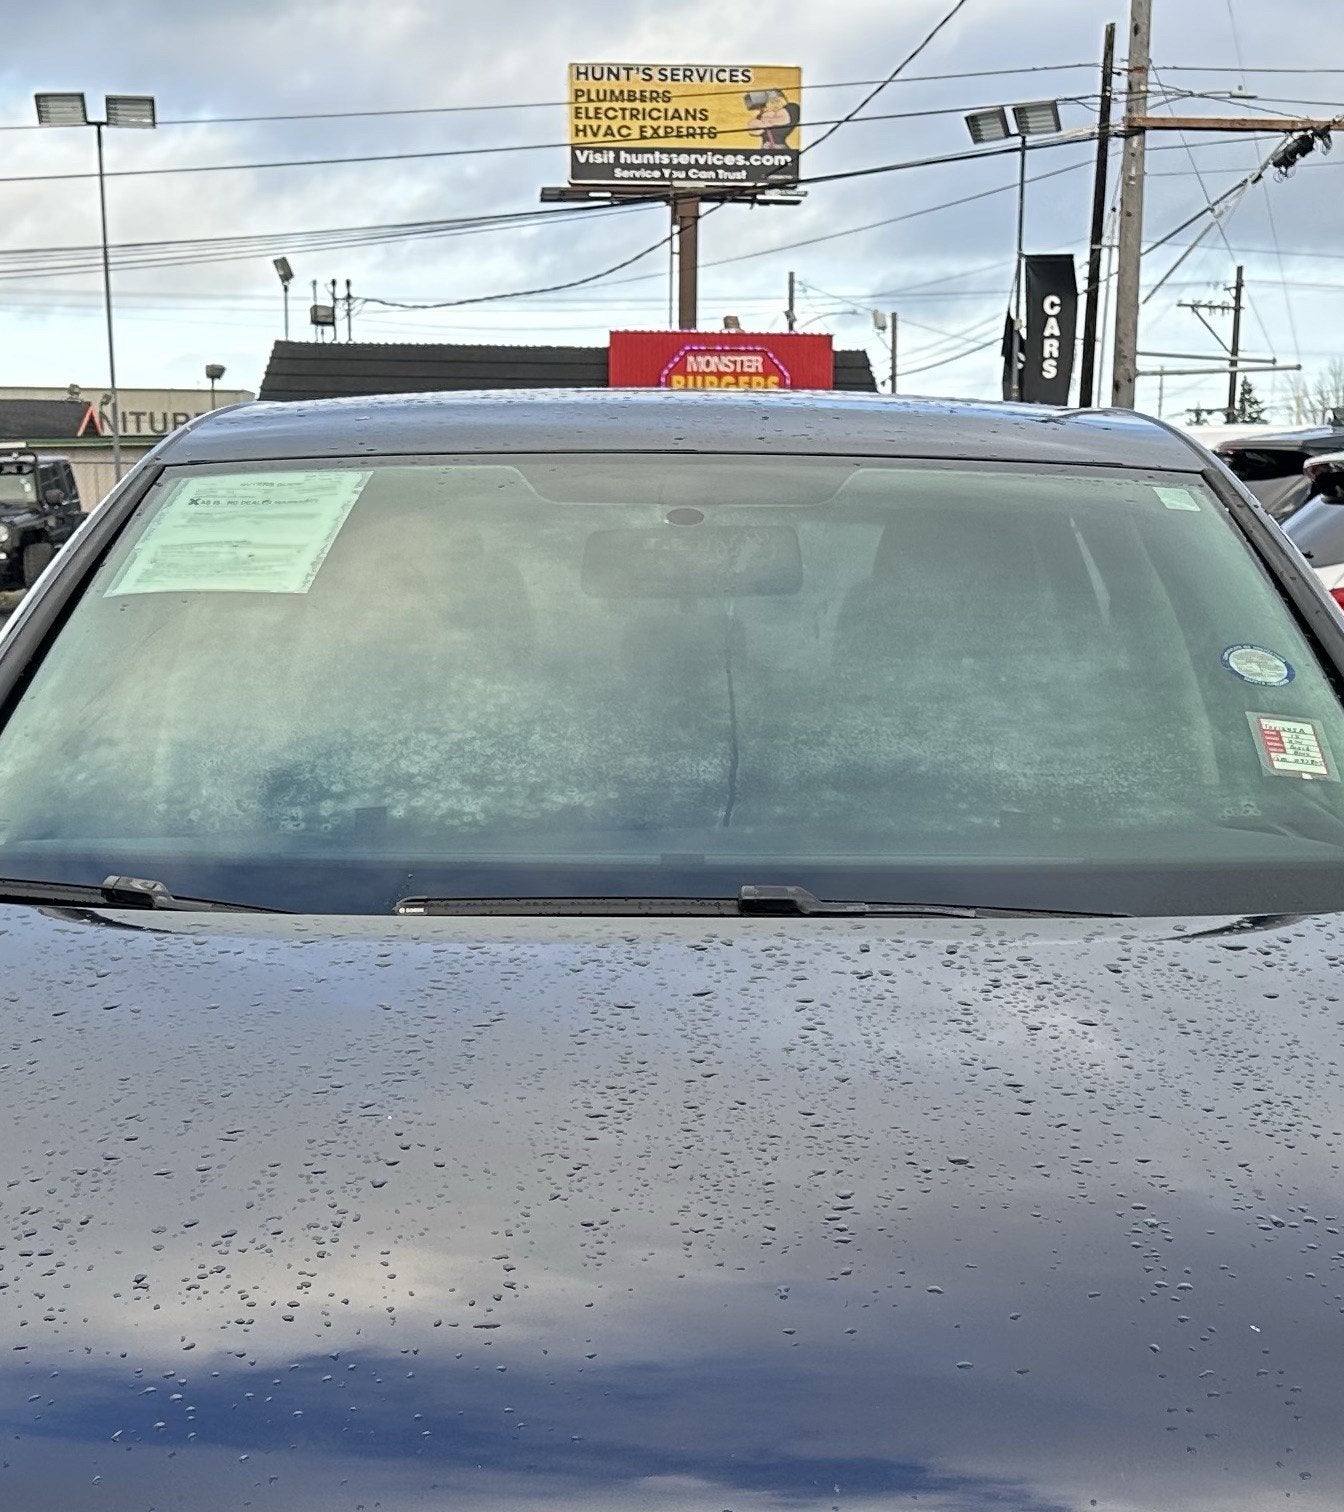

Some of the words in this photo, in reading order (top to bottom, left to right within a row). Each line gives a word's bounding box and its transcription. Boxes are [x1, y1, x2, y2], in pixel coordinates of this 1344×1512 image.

[575, 66, 654, 83] HUNT'S
[658, 67, 752, 84] SERVICES
[573, 88, 672, 104] PLUMBERS
[573, 106, 710, 122] ELECTRICIANS
[573, 124, 634, 139] HVAC
[639, 124, 719, 140] EXPERTS
[574, 150, 616, 165] Visit
[619, 150, 793, 167] huntsservices.com
[613, 167, 661, 179] Service
[662, 168, 686, 179] You
[687, 168, 716, 180] Can
[717, 168, 748, 180] Trust
[1041, 294, 1062, 380] CARS
[686, 354, 764, 374] MONSTER
